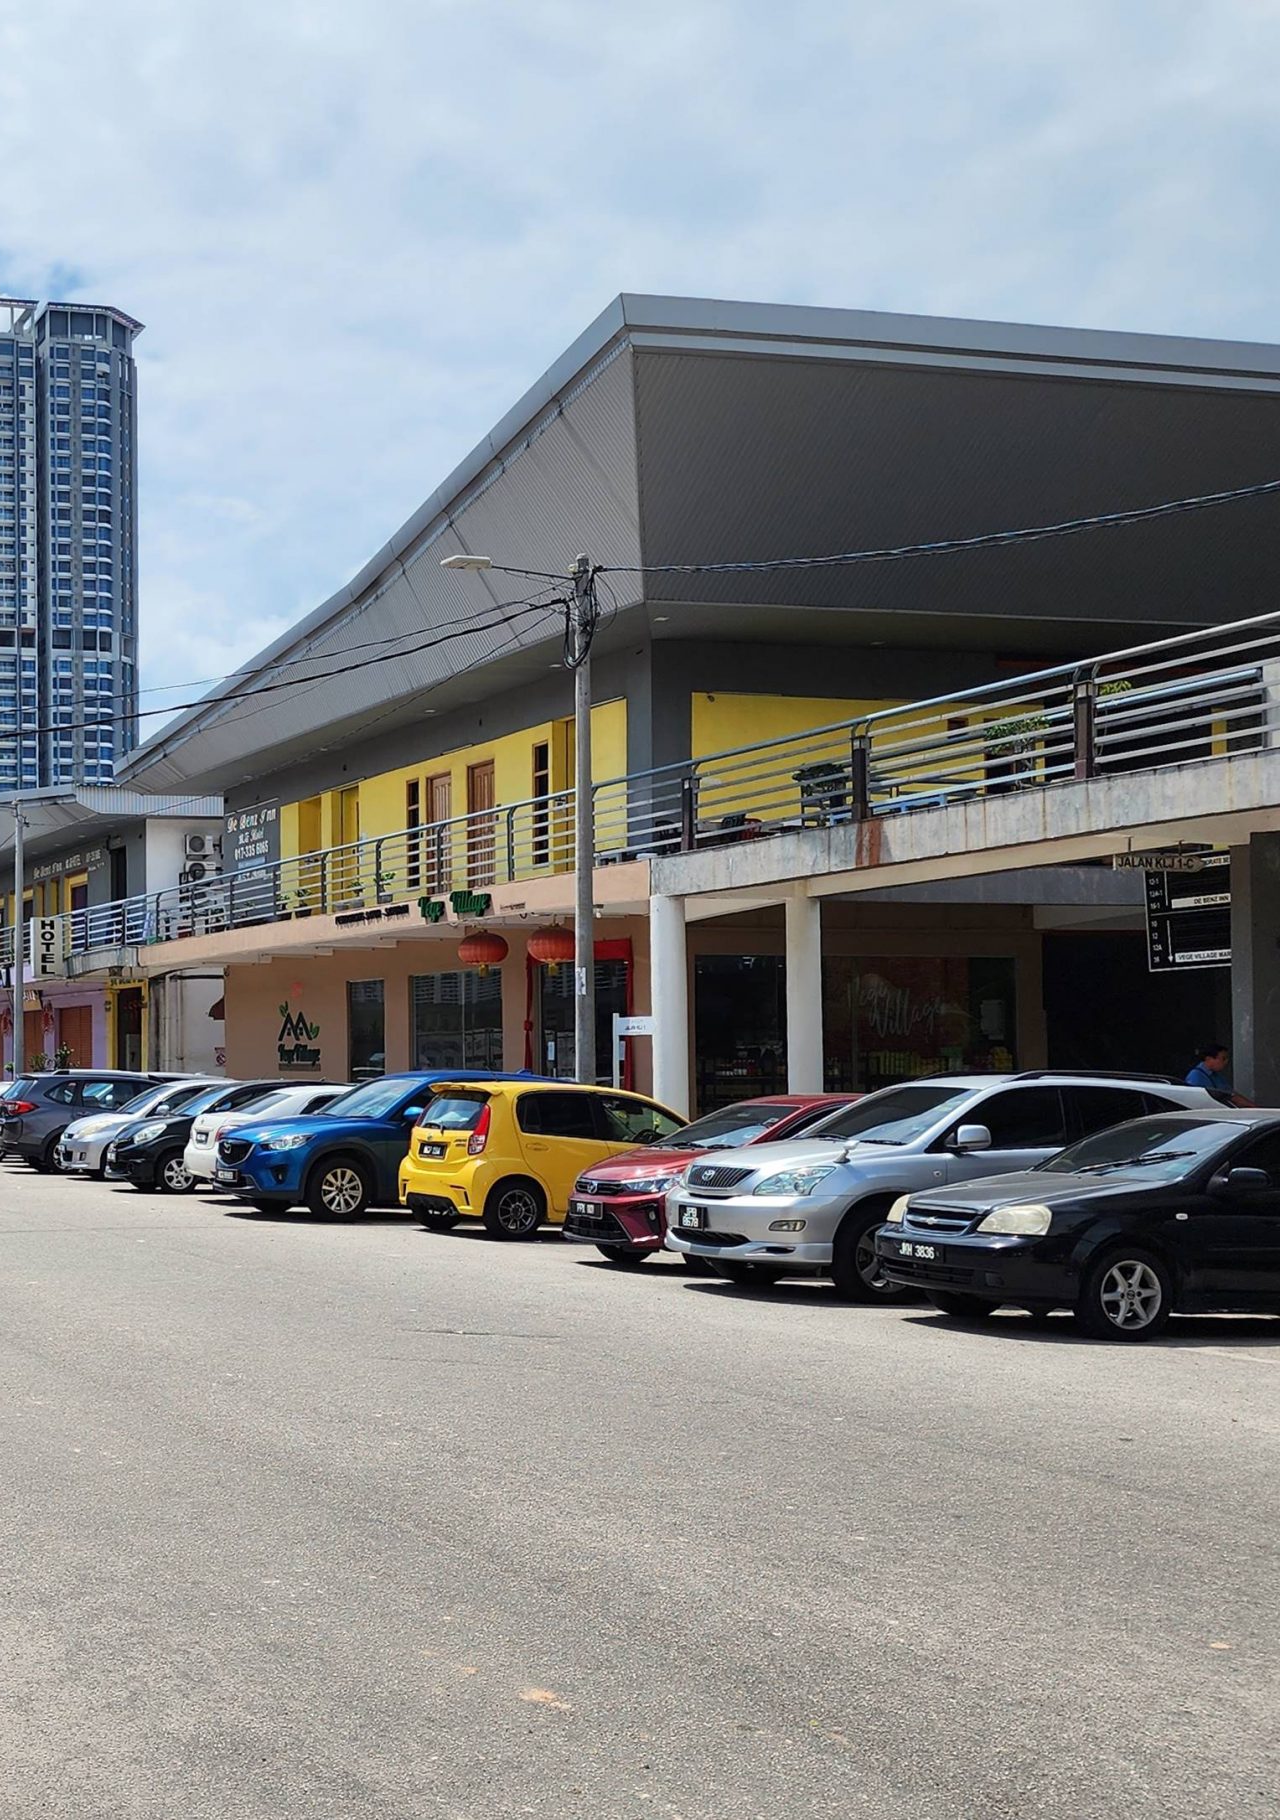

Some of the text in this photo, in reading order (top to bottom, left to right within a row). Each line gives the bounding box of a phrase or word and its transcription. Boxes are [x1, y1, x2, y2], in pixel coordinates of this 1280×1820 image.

[239, 813, 258, 830] Benz
[1118, 857, 1153, 869] JALAN
[1155, 857, 1176, 869] KLJ
[1178, 857, 1195, 869] 1-C
[449, 890, 492, 917] Village
[1203, 896, 1218, 904] BENZ
[40, 919, 56, 975] HOTEL
[1178, 953, 1193, 961] VEGE
[1194, 951, 1217, 960] VILLAGE
[915, 1244, 935, 1260] 3836
